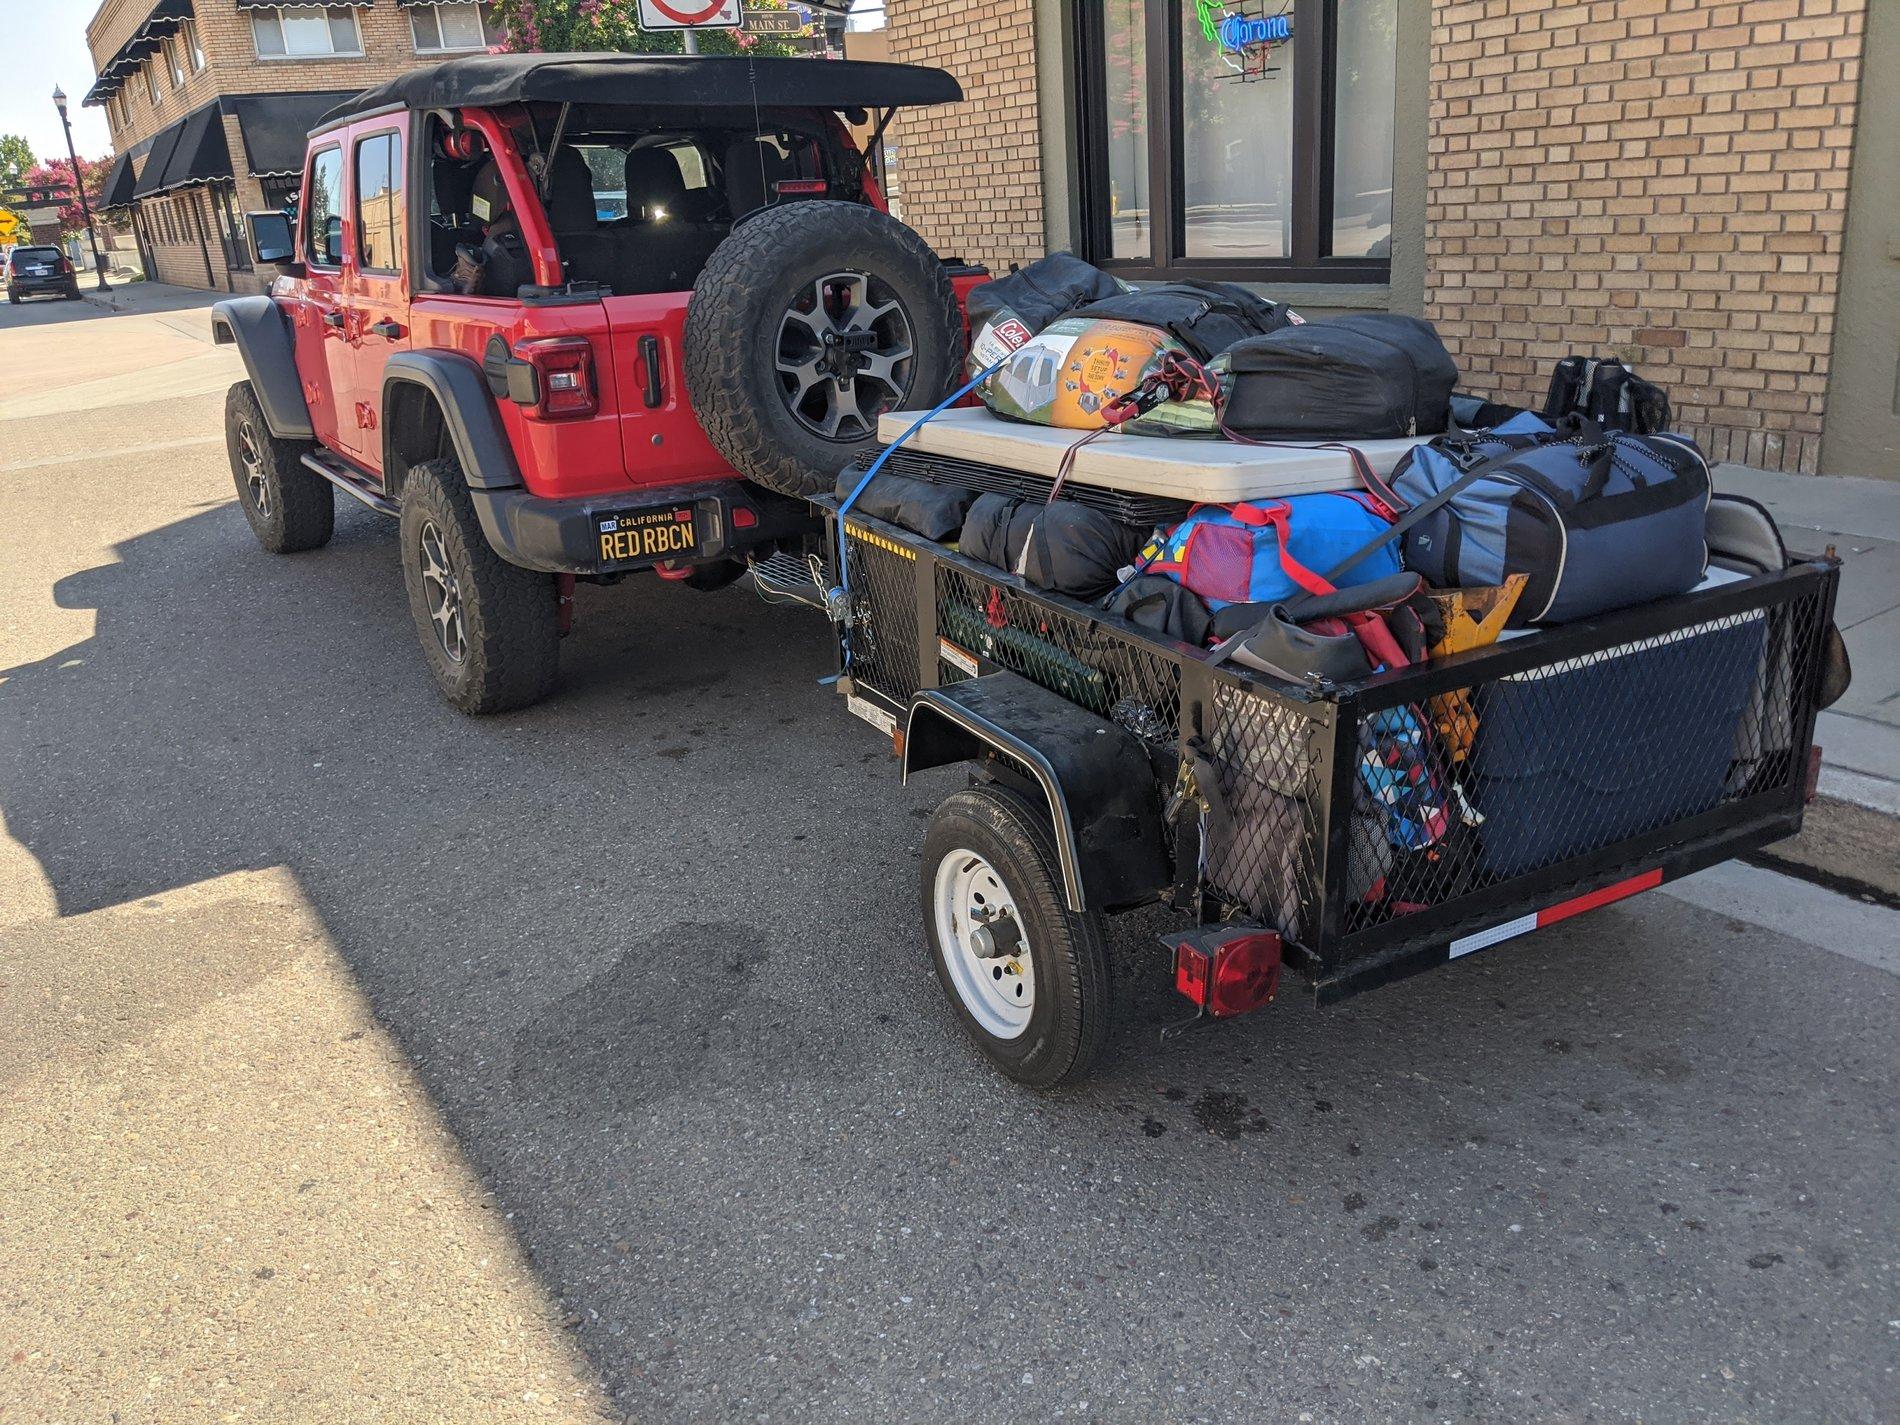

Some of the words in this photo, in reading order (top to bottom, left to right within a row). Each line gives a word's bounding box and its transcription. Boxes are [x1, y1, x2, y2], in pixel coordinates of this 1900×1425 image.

[749, 20, 775, 30] MAIN
[777, 20, 790, 30] ST.
[1221, 16, 1289, 52] Corona
[601, 522, 617, 531] MAR
[620, 512, 673, 527] CALIFORNIA
[600, 530, 640, 560] RED
[643, 522, 694, 554] RBCN
